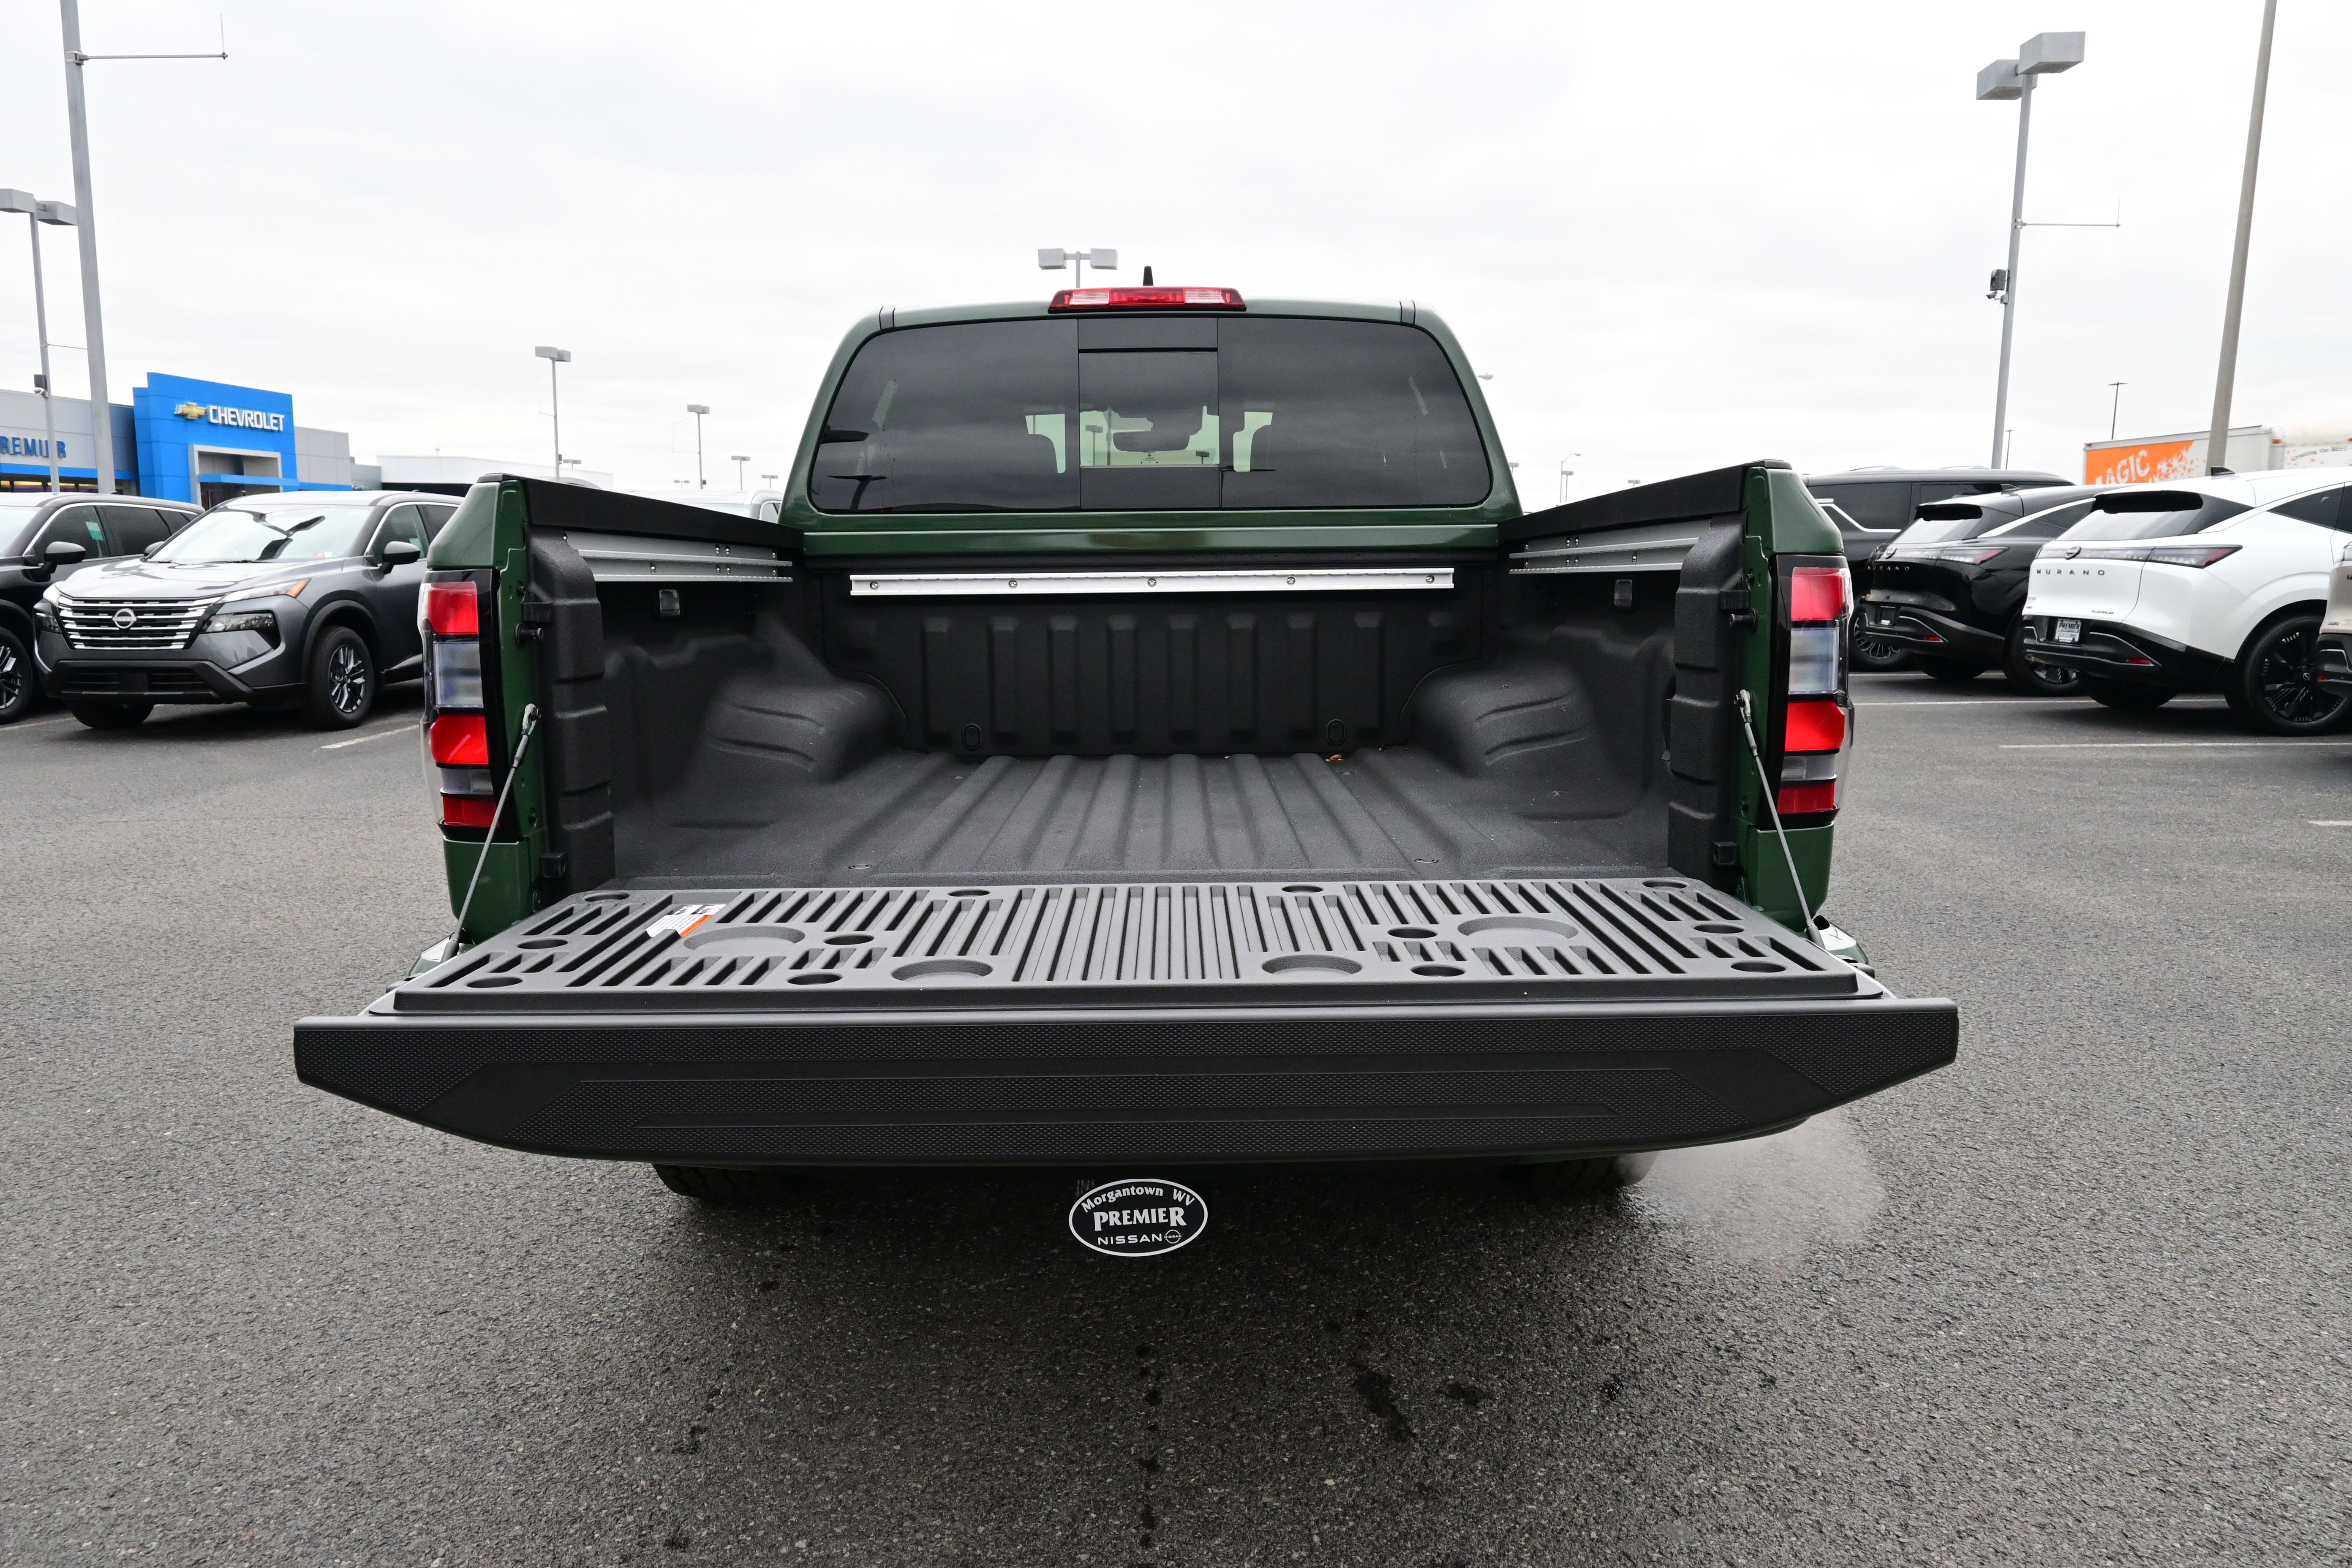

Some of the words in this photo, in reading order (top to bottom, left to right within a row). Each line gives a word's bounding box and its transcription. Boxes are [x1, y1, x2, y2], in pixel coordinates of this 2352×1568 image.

[209, 405, 284, 431] CHEVROLET
[1081, 1185, 1163, 1213] Morgantown
[1173, 1188, 1195, 1206] WV
[1093, 1207, 1187, 1231] PREMIER
[1098, 1233, 1162, 1245] NISSAN
